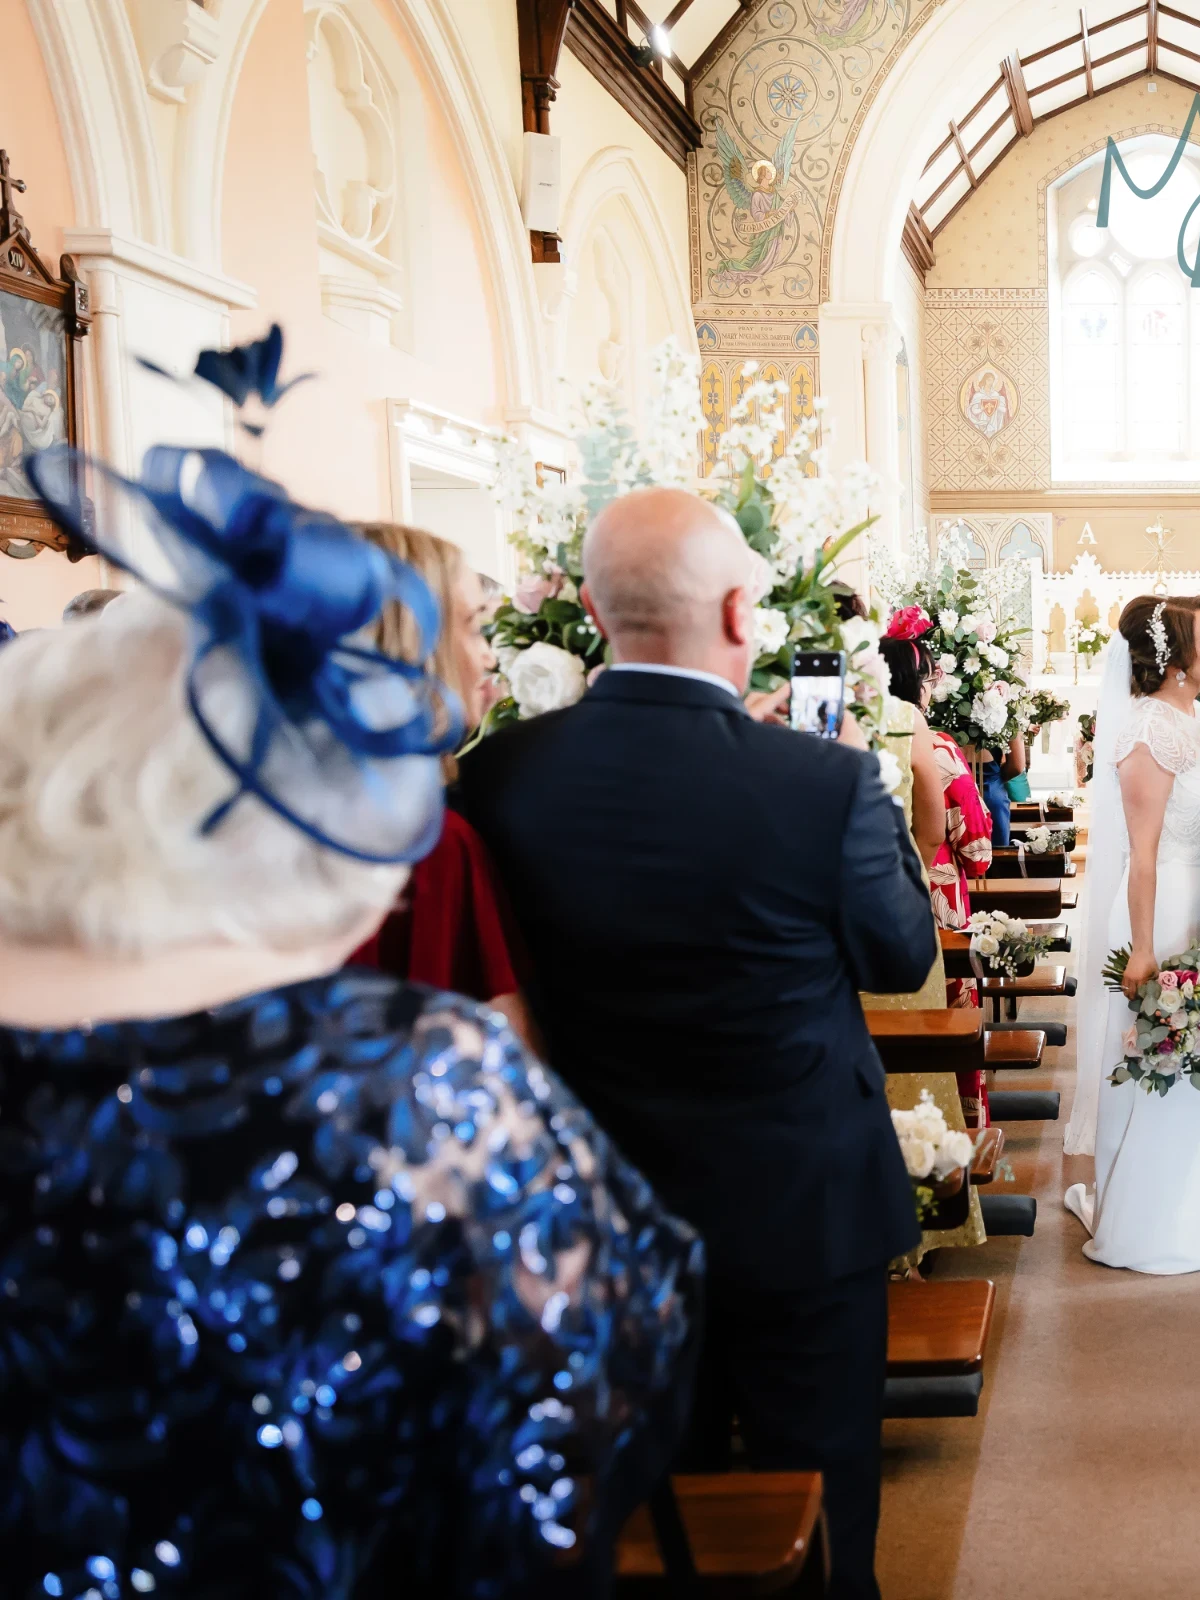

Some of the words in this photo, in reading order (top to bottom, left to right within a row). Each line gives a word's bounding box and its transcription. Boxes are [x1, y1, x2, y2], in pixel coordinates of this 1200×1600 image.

[739, 222, 764, 233] GLORIA
[10, 250, 24, 269] XIV
[721, 332, 738, 340] MARY
